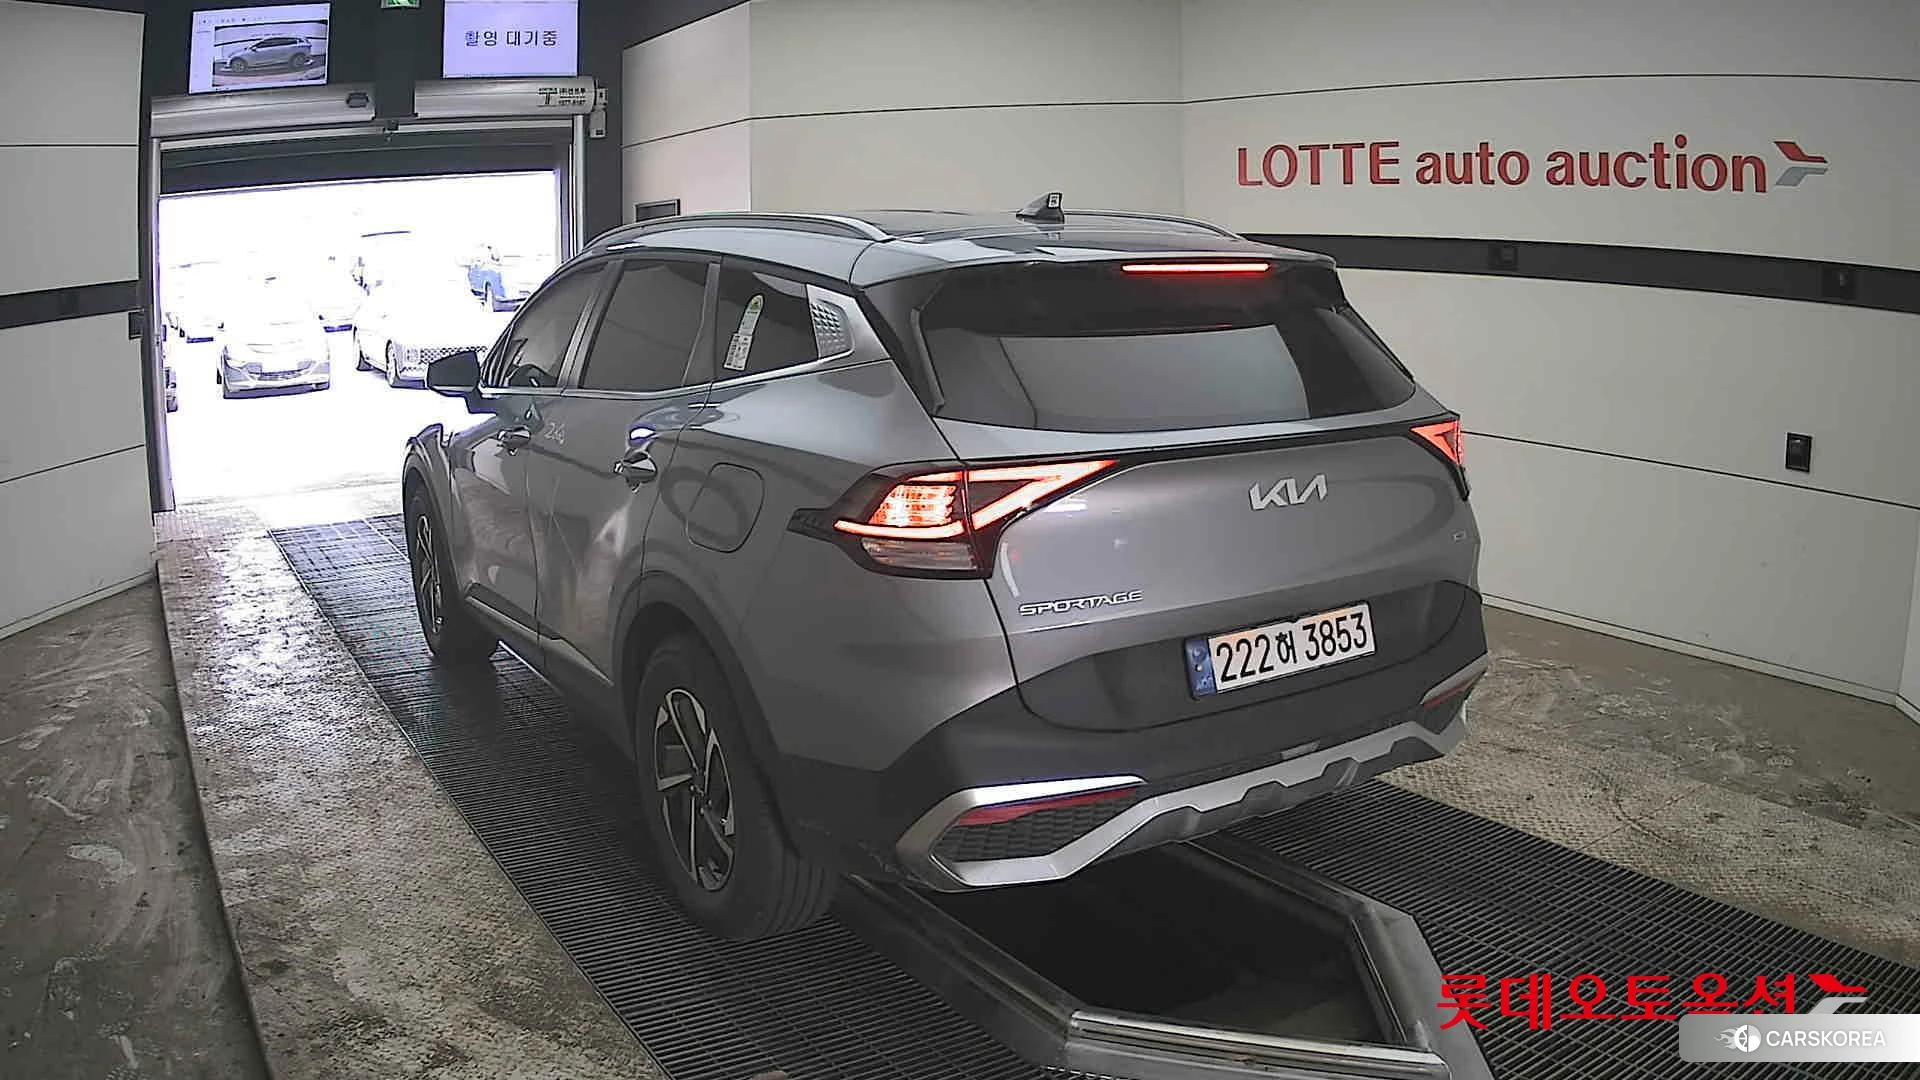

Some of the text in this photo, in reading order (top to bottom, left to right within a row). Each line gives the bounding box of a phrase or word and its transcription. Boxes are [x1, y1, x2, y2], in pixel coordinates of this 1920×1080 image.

[505, 30, 558, 47] 대기중
[1237, 133, 1767, 193] LOTTE auto auction
[1248, 473, 1328, 511] KIA
[1019, 590, 1143, 616] SPORTAGE
[1302, 611, 1368, 662] 3853
